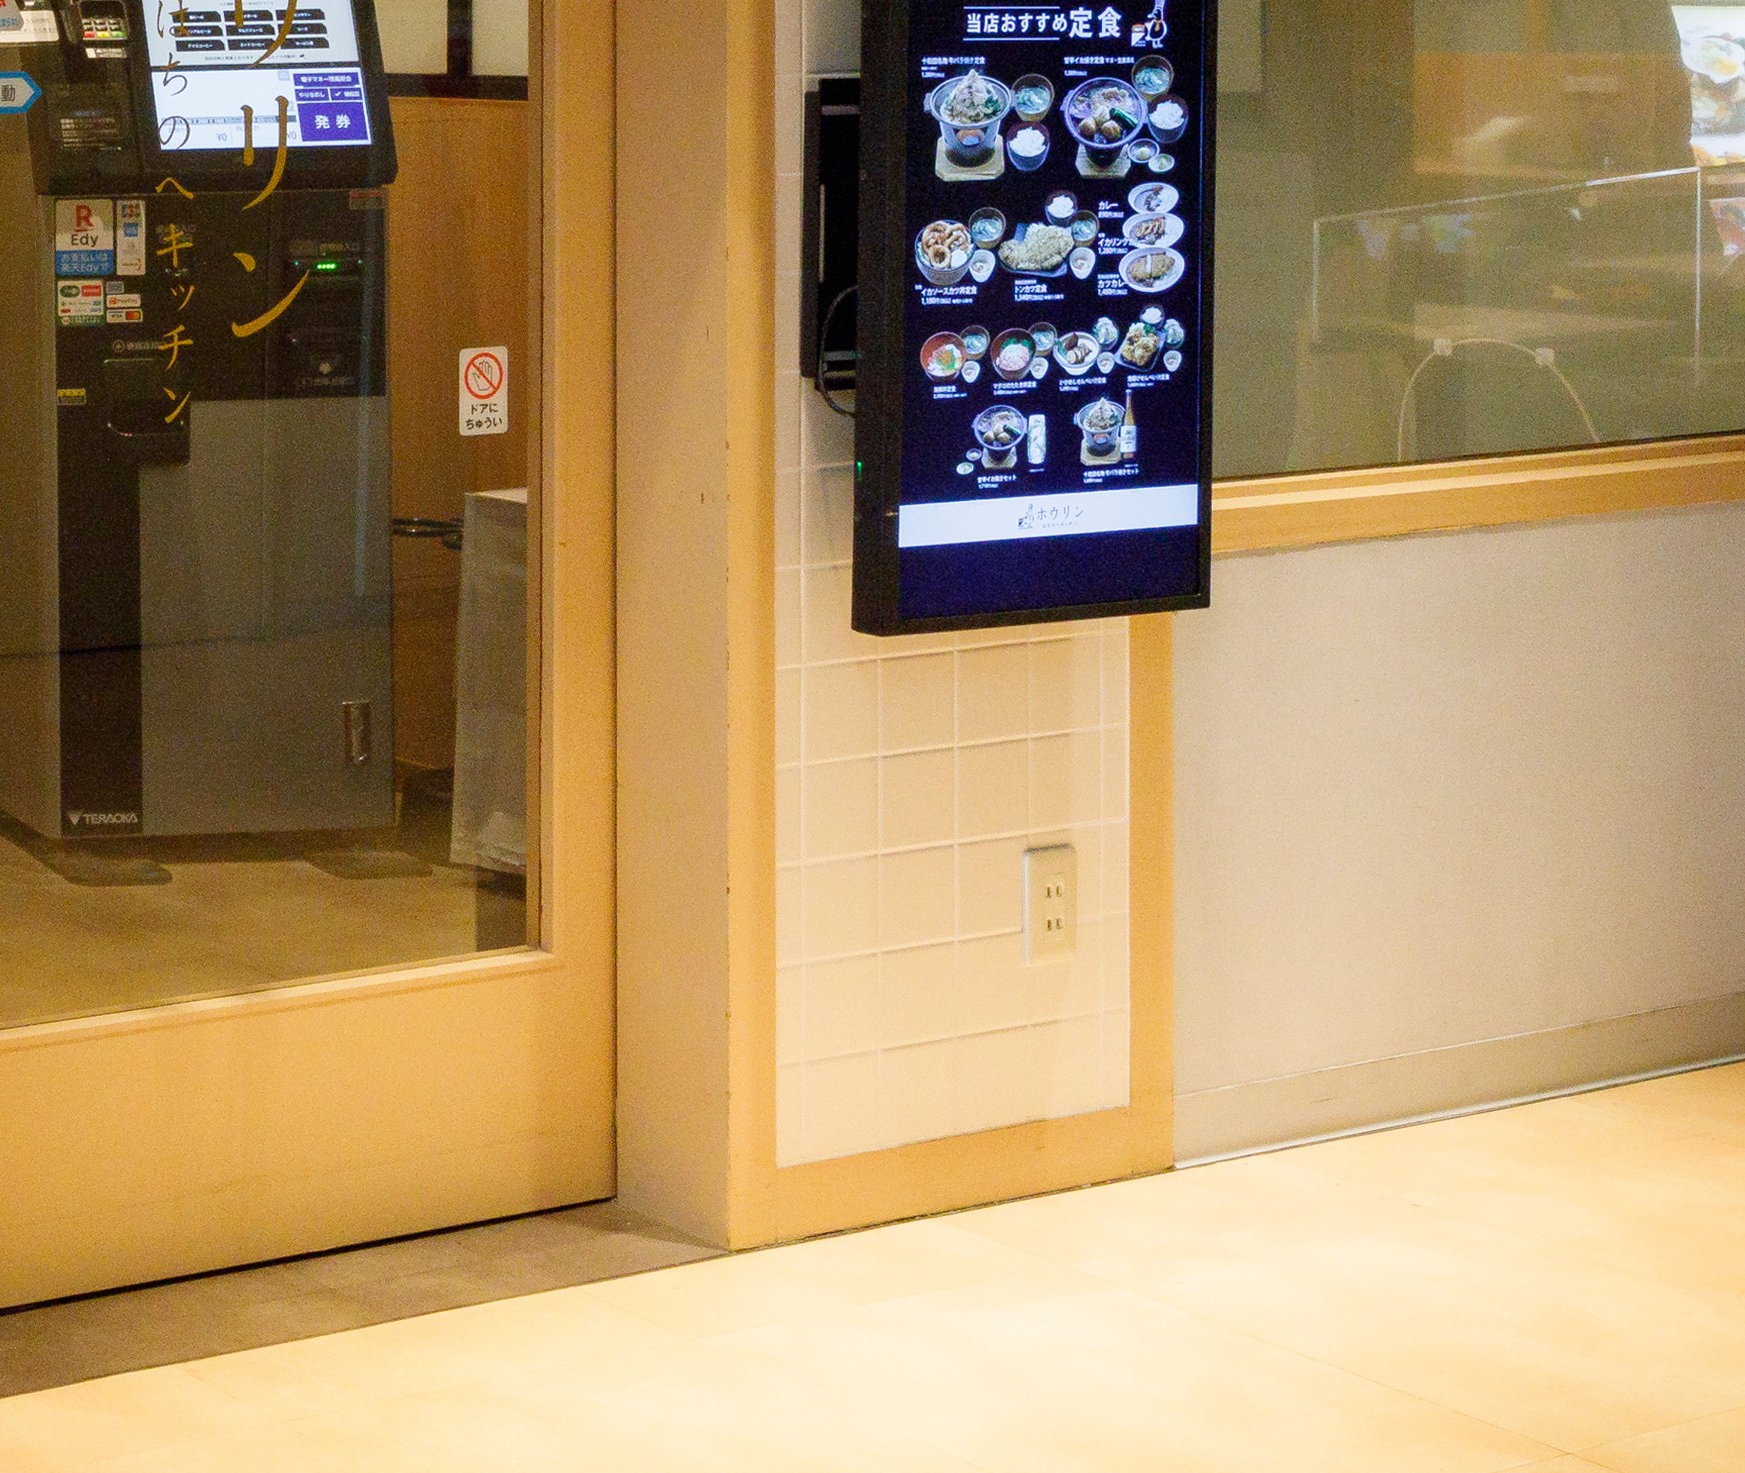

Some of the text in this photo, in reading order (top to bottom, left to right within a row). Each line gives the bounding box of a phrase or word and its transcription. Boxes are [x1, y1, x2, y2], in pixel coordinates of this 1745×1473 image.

[966, 6, 1122, 39] 当店おすすめ定食
[314, 113, 352, 130] 発券
[1098, 201, 1119, 211] カレー
[70, 234, 99, 248] Edy
[470, 403, 499, 415] ドアに
[465, 416, 503, 430] ちゅうい
[1037, 505, 1084, 521] ホウリン
[82, 812, 138, 824] TERAOKA
